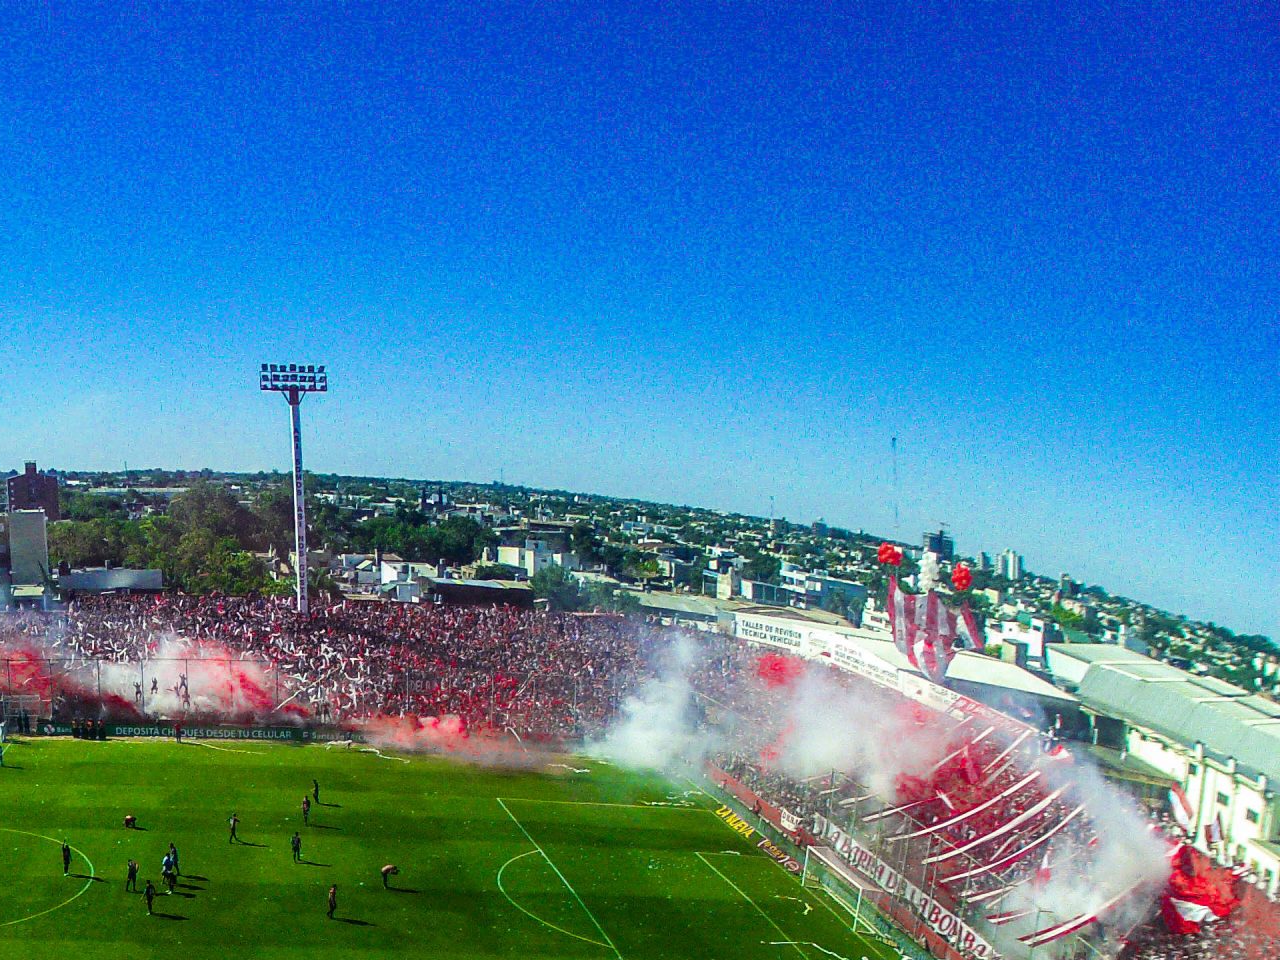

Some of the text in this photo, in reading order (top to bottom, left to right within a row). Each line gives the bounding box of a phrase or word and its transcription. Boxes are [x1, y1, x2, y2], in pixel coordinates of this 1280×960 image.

[742, 620, 763, 630] TALLER
[206, 728, 237, 738] DESDE
[238, 730, 250, 738] TU
[251, 730, 292, 739] CELULAR
[726, 811, 755, 838] NUEVA
[928, 908, 989, 958] BOMBA
